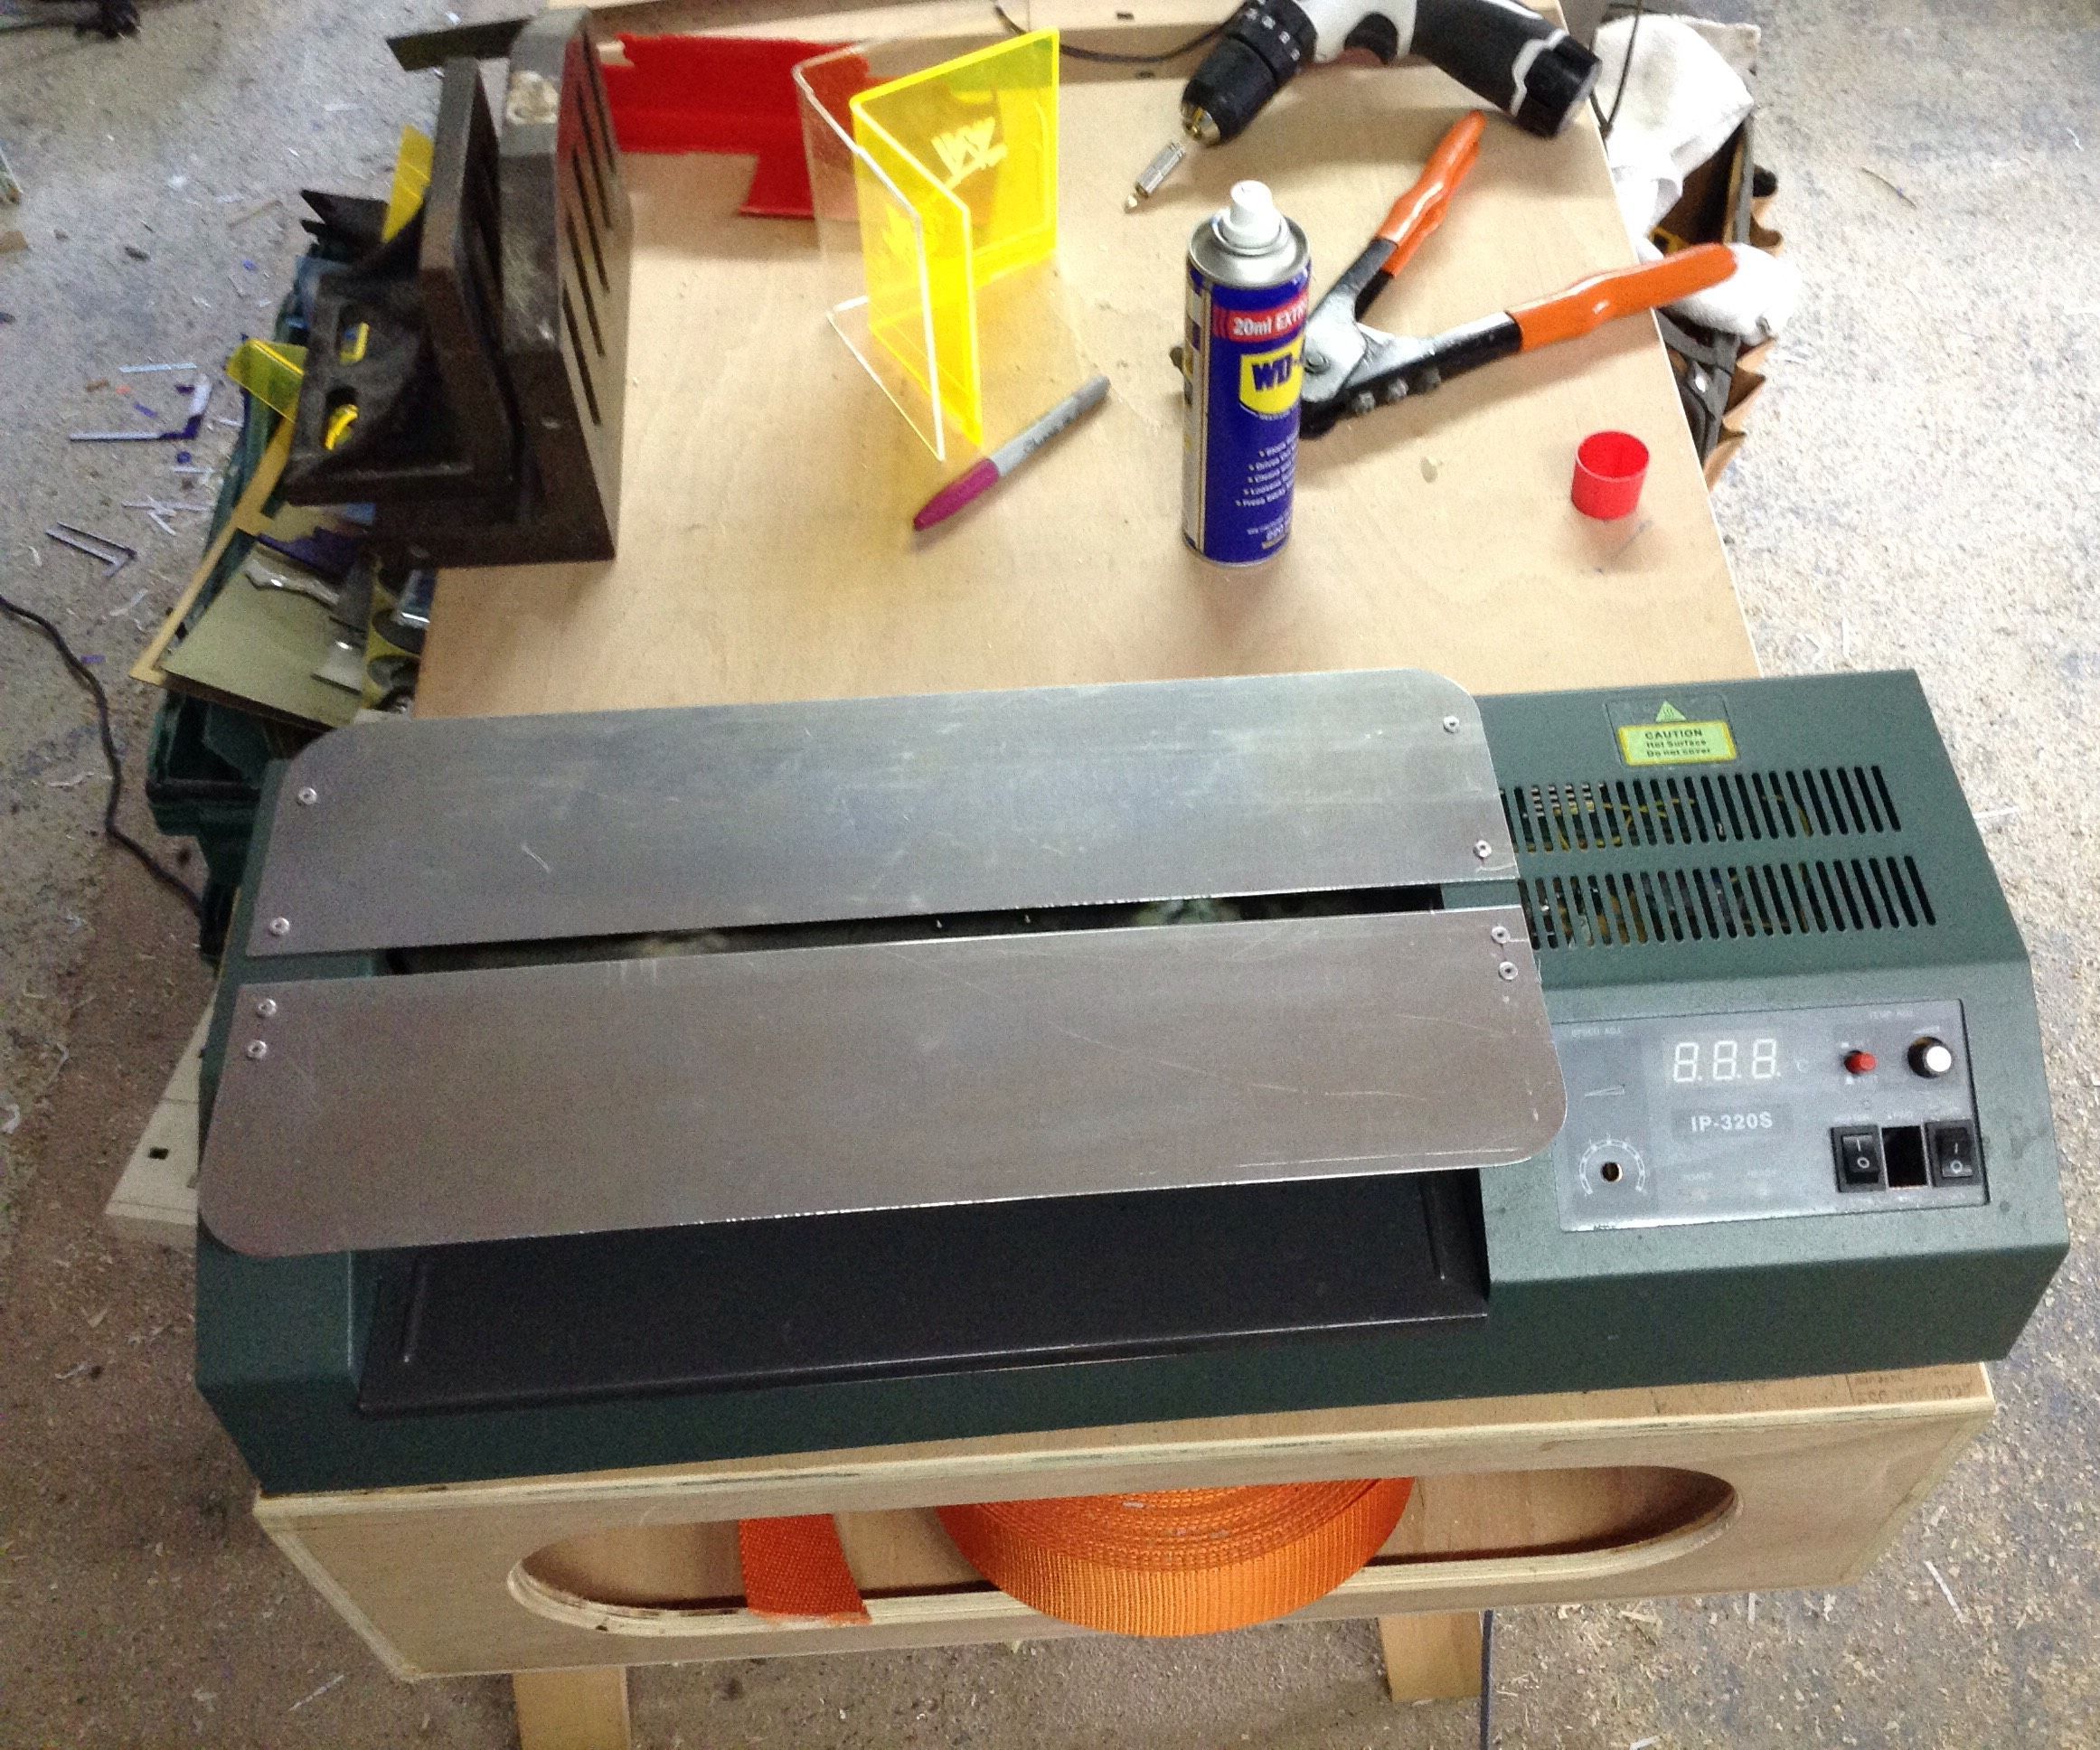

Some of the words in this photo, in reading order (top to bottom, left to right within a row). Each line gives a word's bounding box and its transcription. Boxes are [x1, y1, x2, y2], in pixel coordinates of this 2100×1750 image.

[1233, 315, 1272, 336] 20ml
[1275, 301, 1304, 333] EXTR
[1644, 729, 1702, 740] CAUTION
[1690, 1110, 1774, 1134] IP-320S
